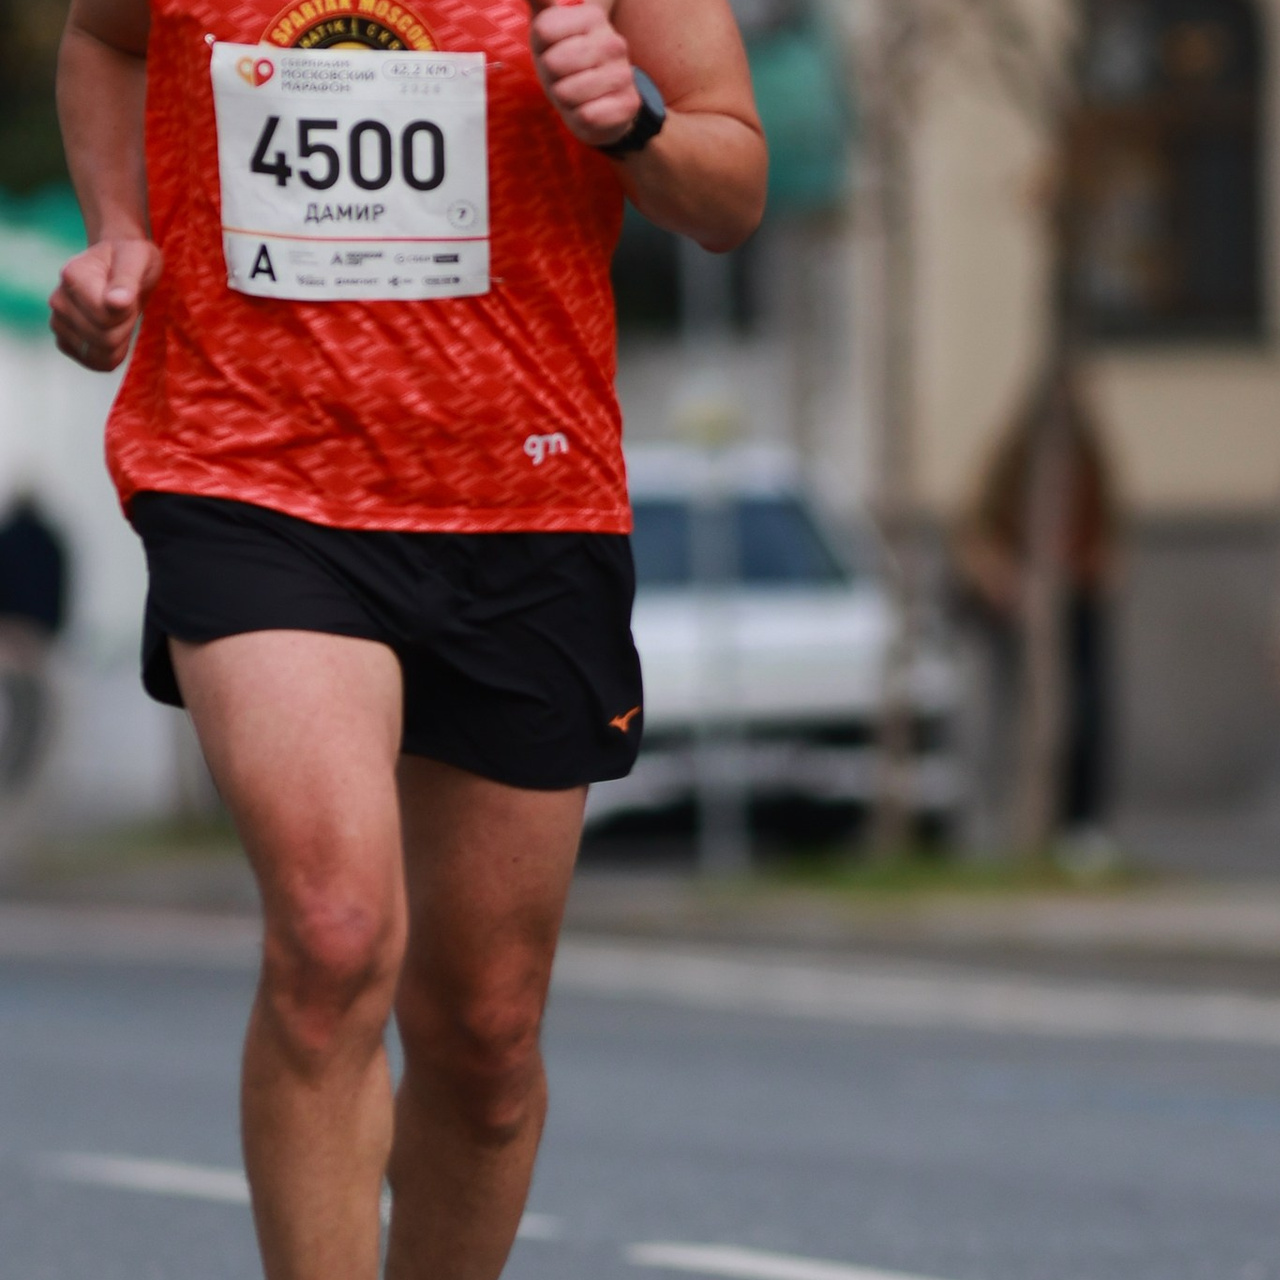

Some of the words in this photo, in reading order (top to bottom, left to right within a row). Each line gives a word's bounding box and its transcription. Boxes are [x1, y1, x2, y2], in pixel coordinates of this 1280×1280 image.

[281, 67, 376, 80] МОСКОВСКИЙ
[281, 80, 351, 92] МАРАФОН
[250, 115, 445, 191] 4500
[304, 202, 386, 224] ДАМИР
[249, 243, 277, 282] A
